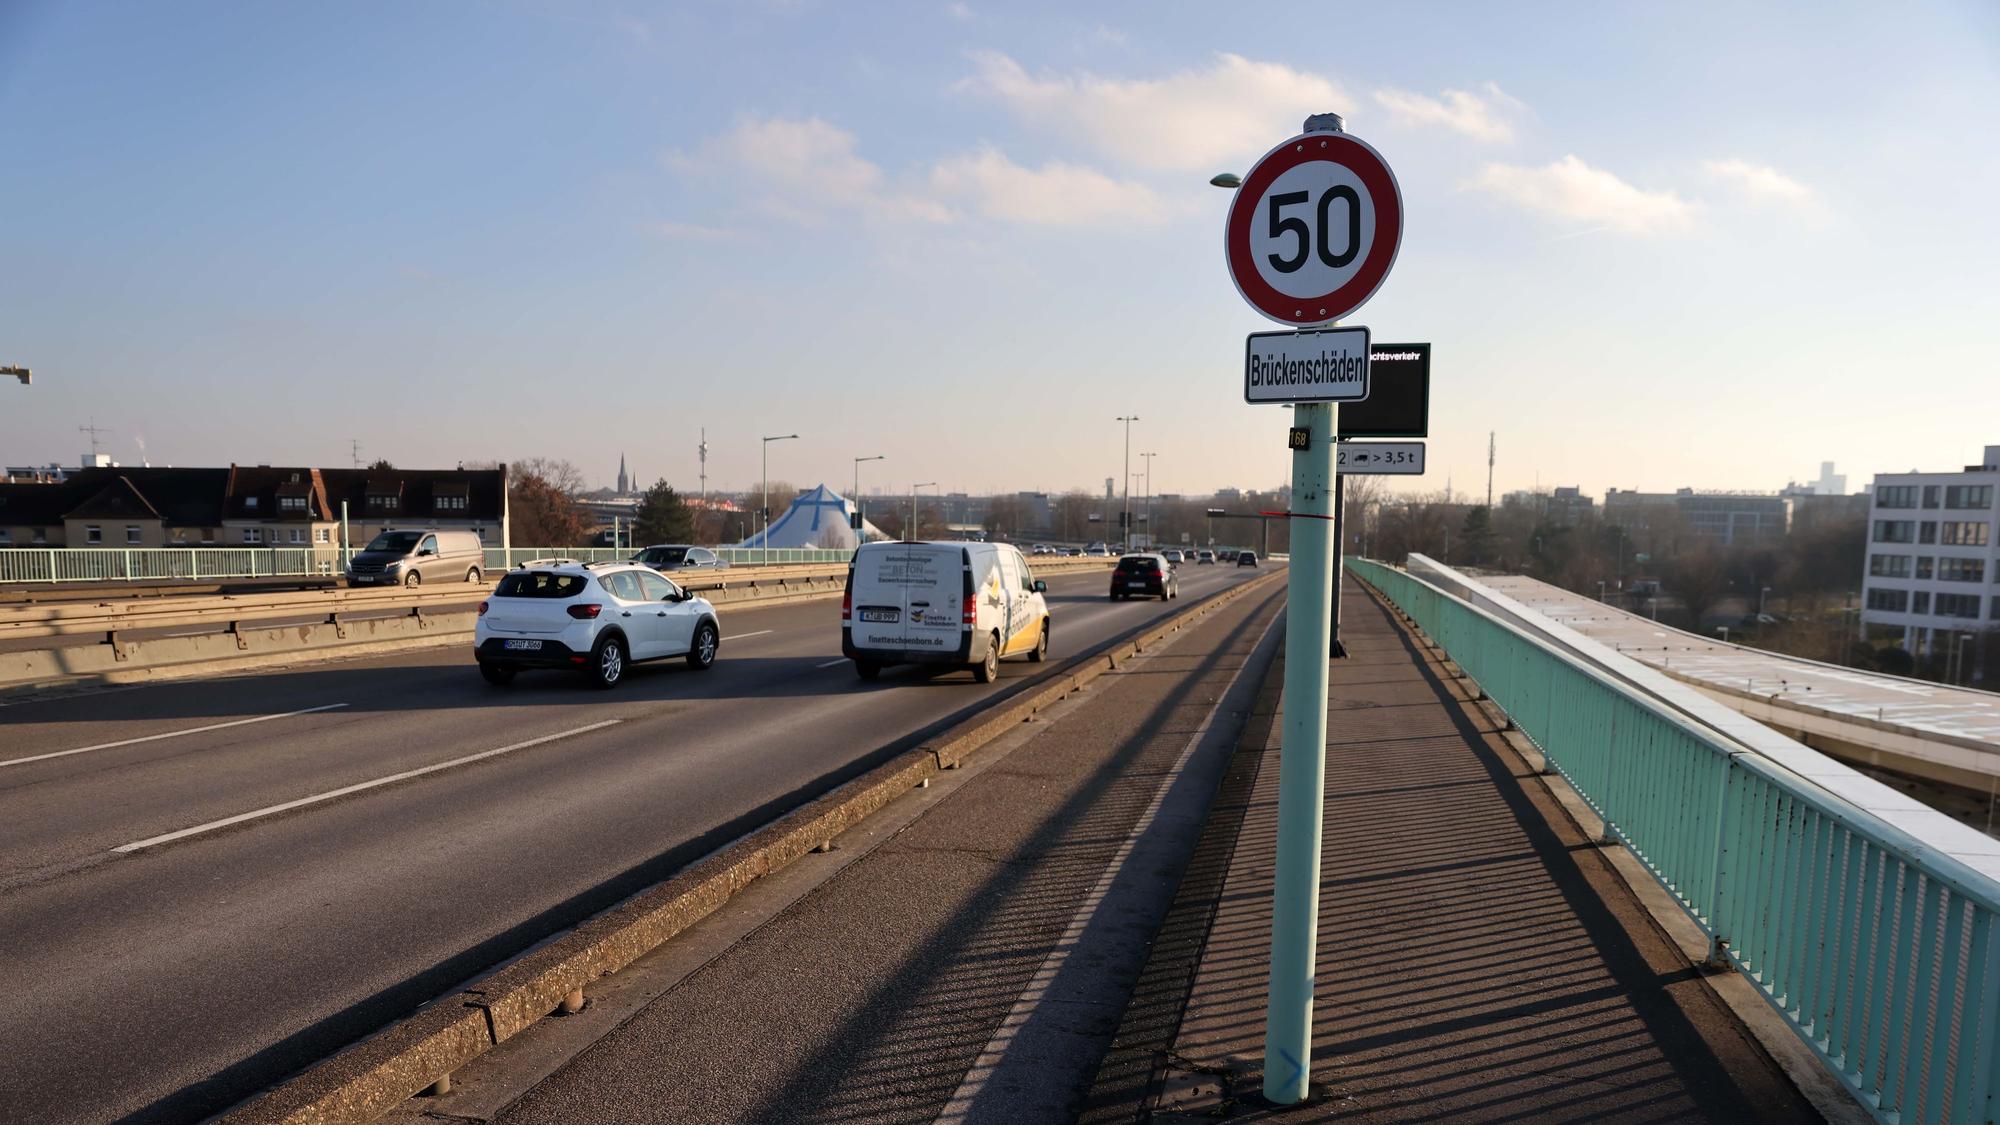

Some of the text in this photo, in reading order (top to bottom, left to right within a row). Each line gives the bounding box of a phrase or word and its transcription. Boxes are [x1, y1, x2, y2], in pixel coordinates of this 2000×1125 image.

[1268, 184, 1361, 273] 50
[1251, 349, 1363, 387] Brückenschäden
[1290, 431, 1307, 446] 168
[1385, 451, 1405, 465] 3,5
[1408, 453, 1414, 463] t
[868, 635, 944, 646] finetteschoenborn.de
